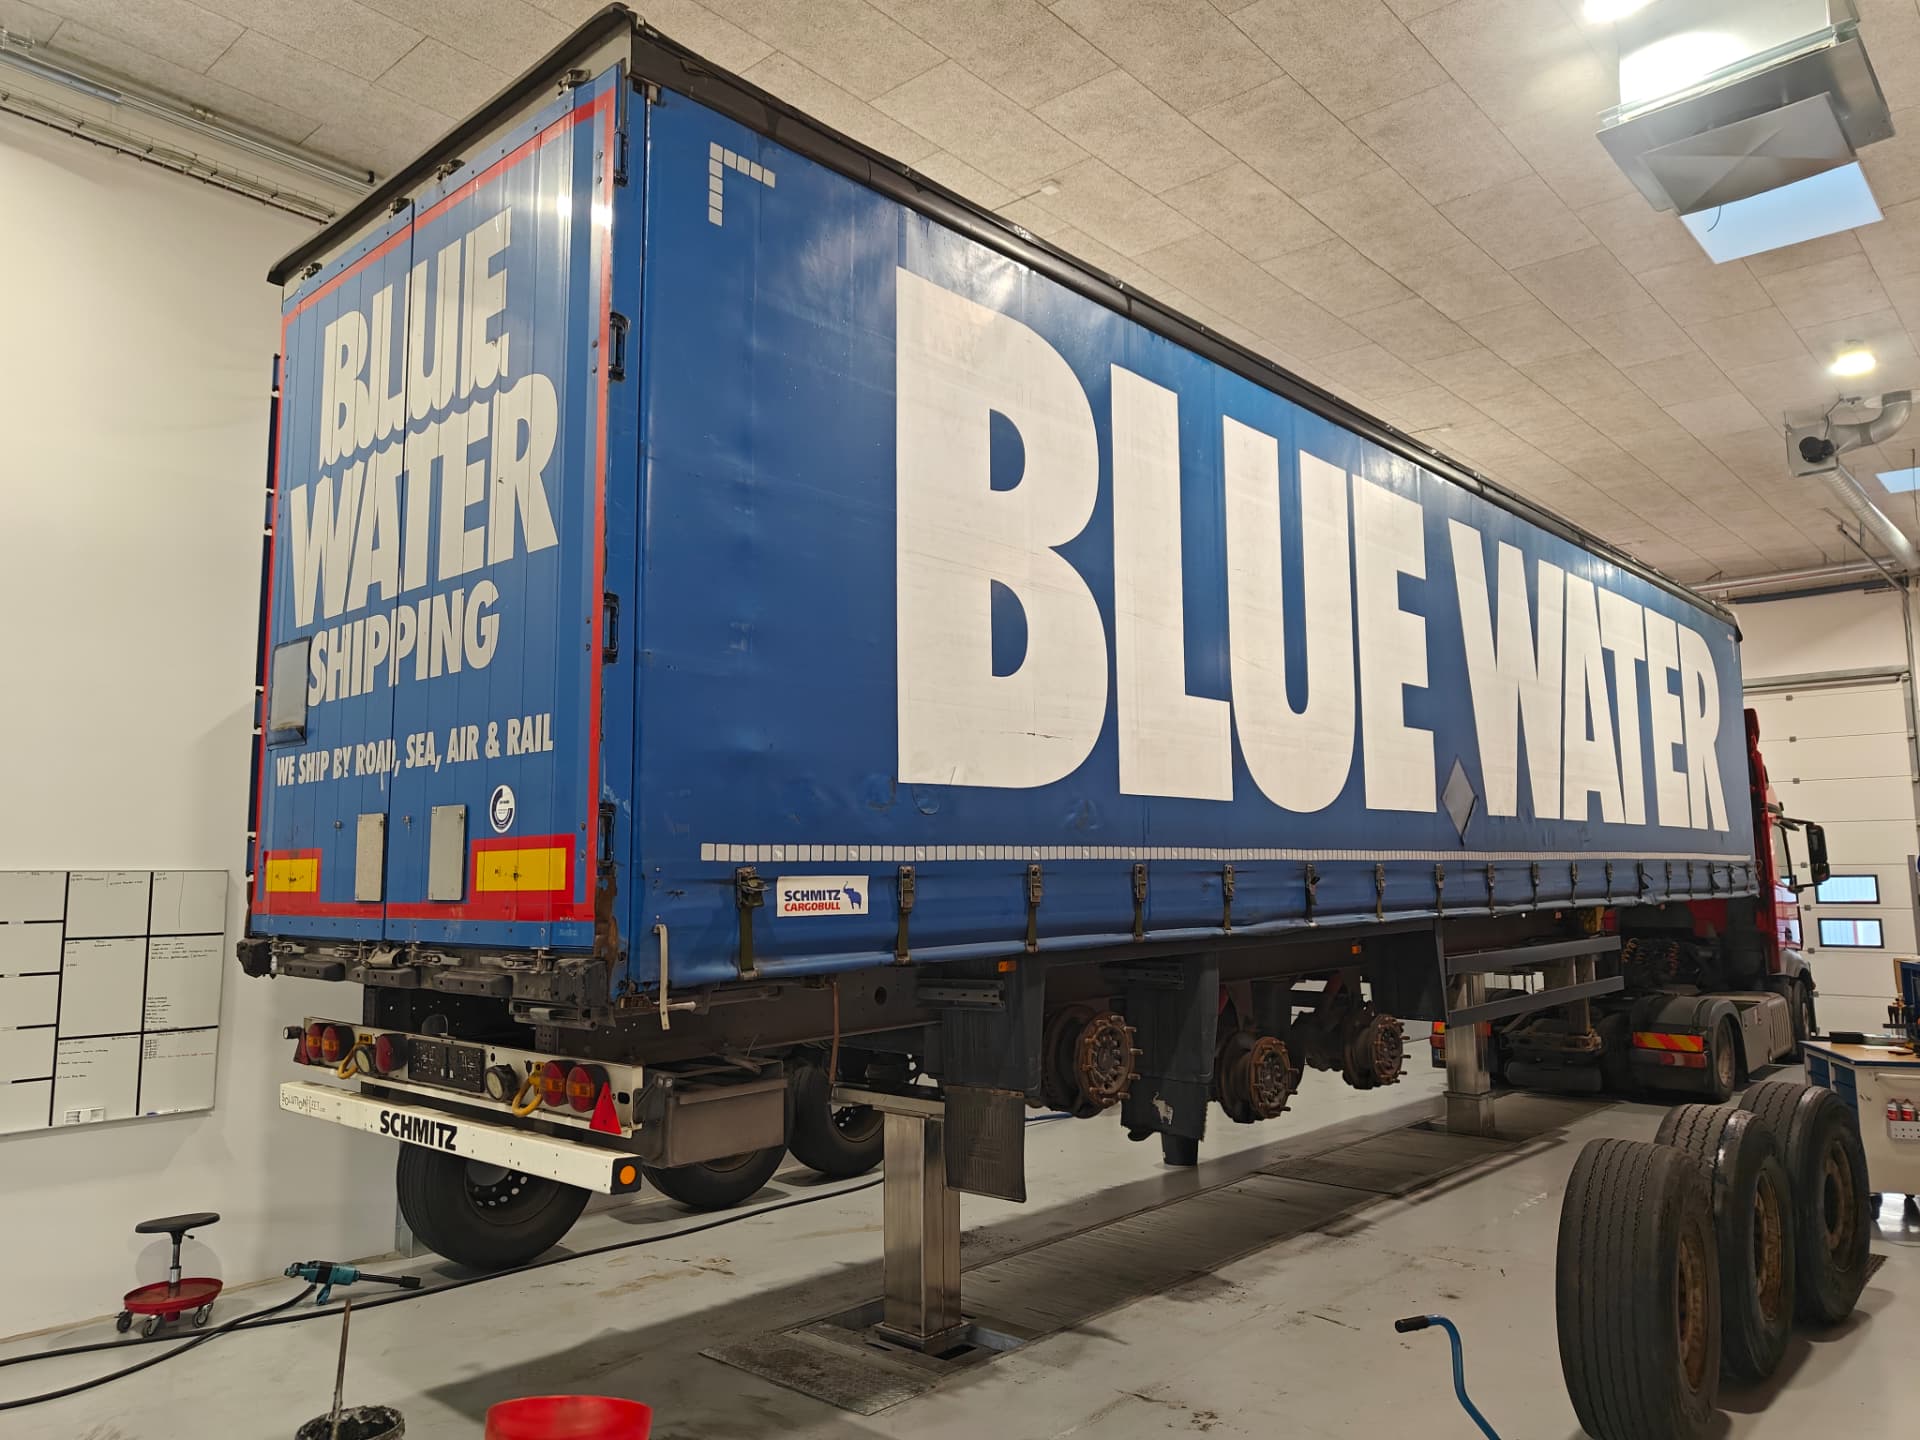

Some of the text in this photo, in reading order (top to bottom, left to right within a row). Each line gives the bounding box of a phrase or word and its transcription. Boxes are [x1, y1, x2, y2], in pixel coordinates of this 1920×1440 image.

[319, 206, 512, 471] BLUE
[290, 373, 559, 628] WATER
[896, 266, 1730, 832] BLUE WATER
[308, 580, 500, 707] SHIPPING
[276, 713, 553, 787] WE SHIP BY ROAD, SEA, AIR & RAIL
[784, 889, 841, 902] SCHMITZ
[784, 902, 841, 912] CARGOBULL
[380, 1110, 458, 1151] SCHMITZ
